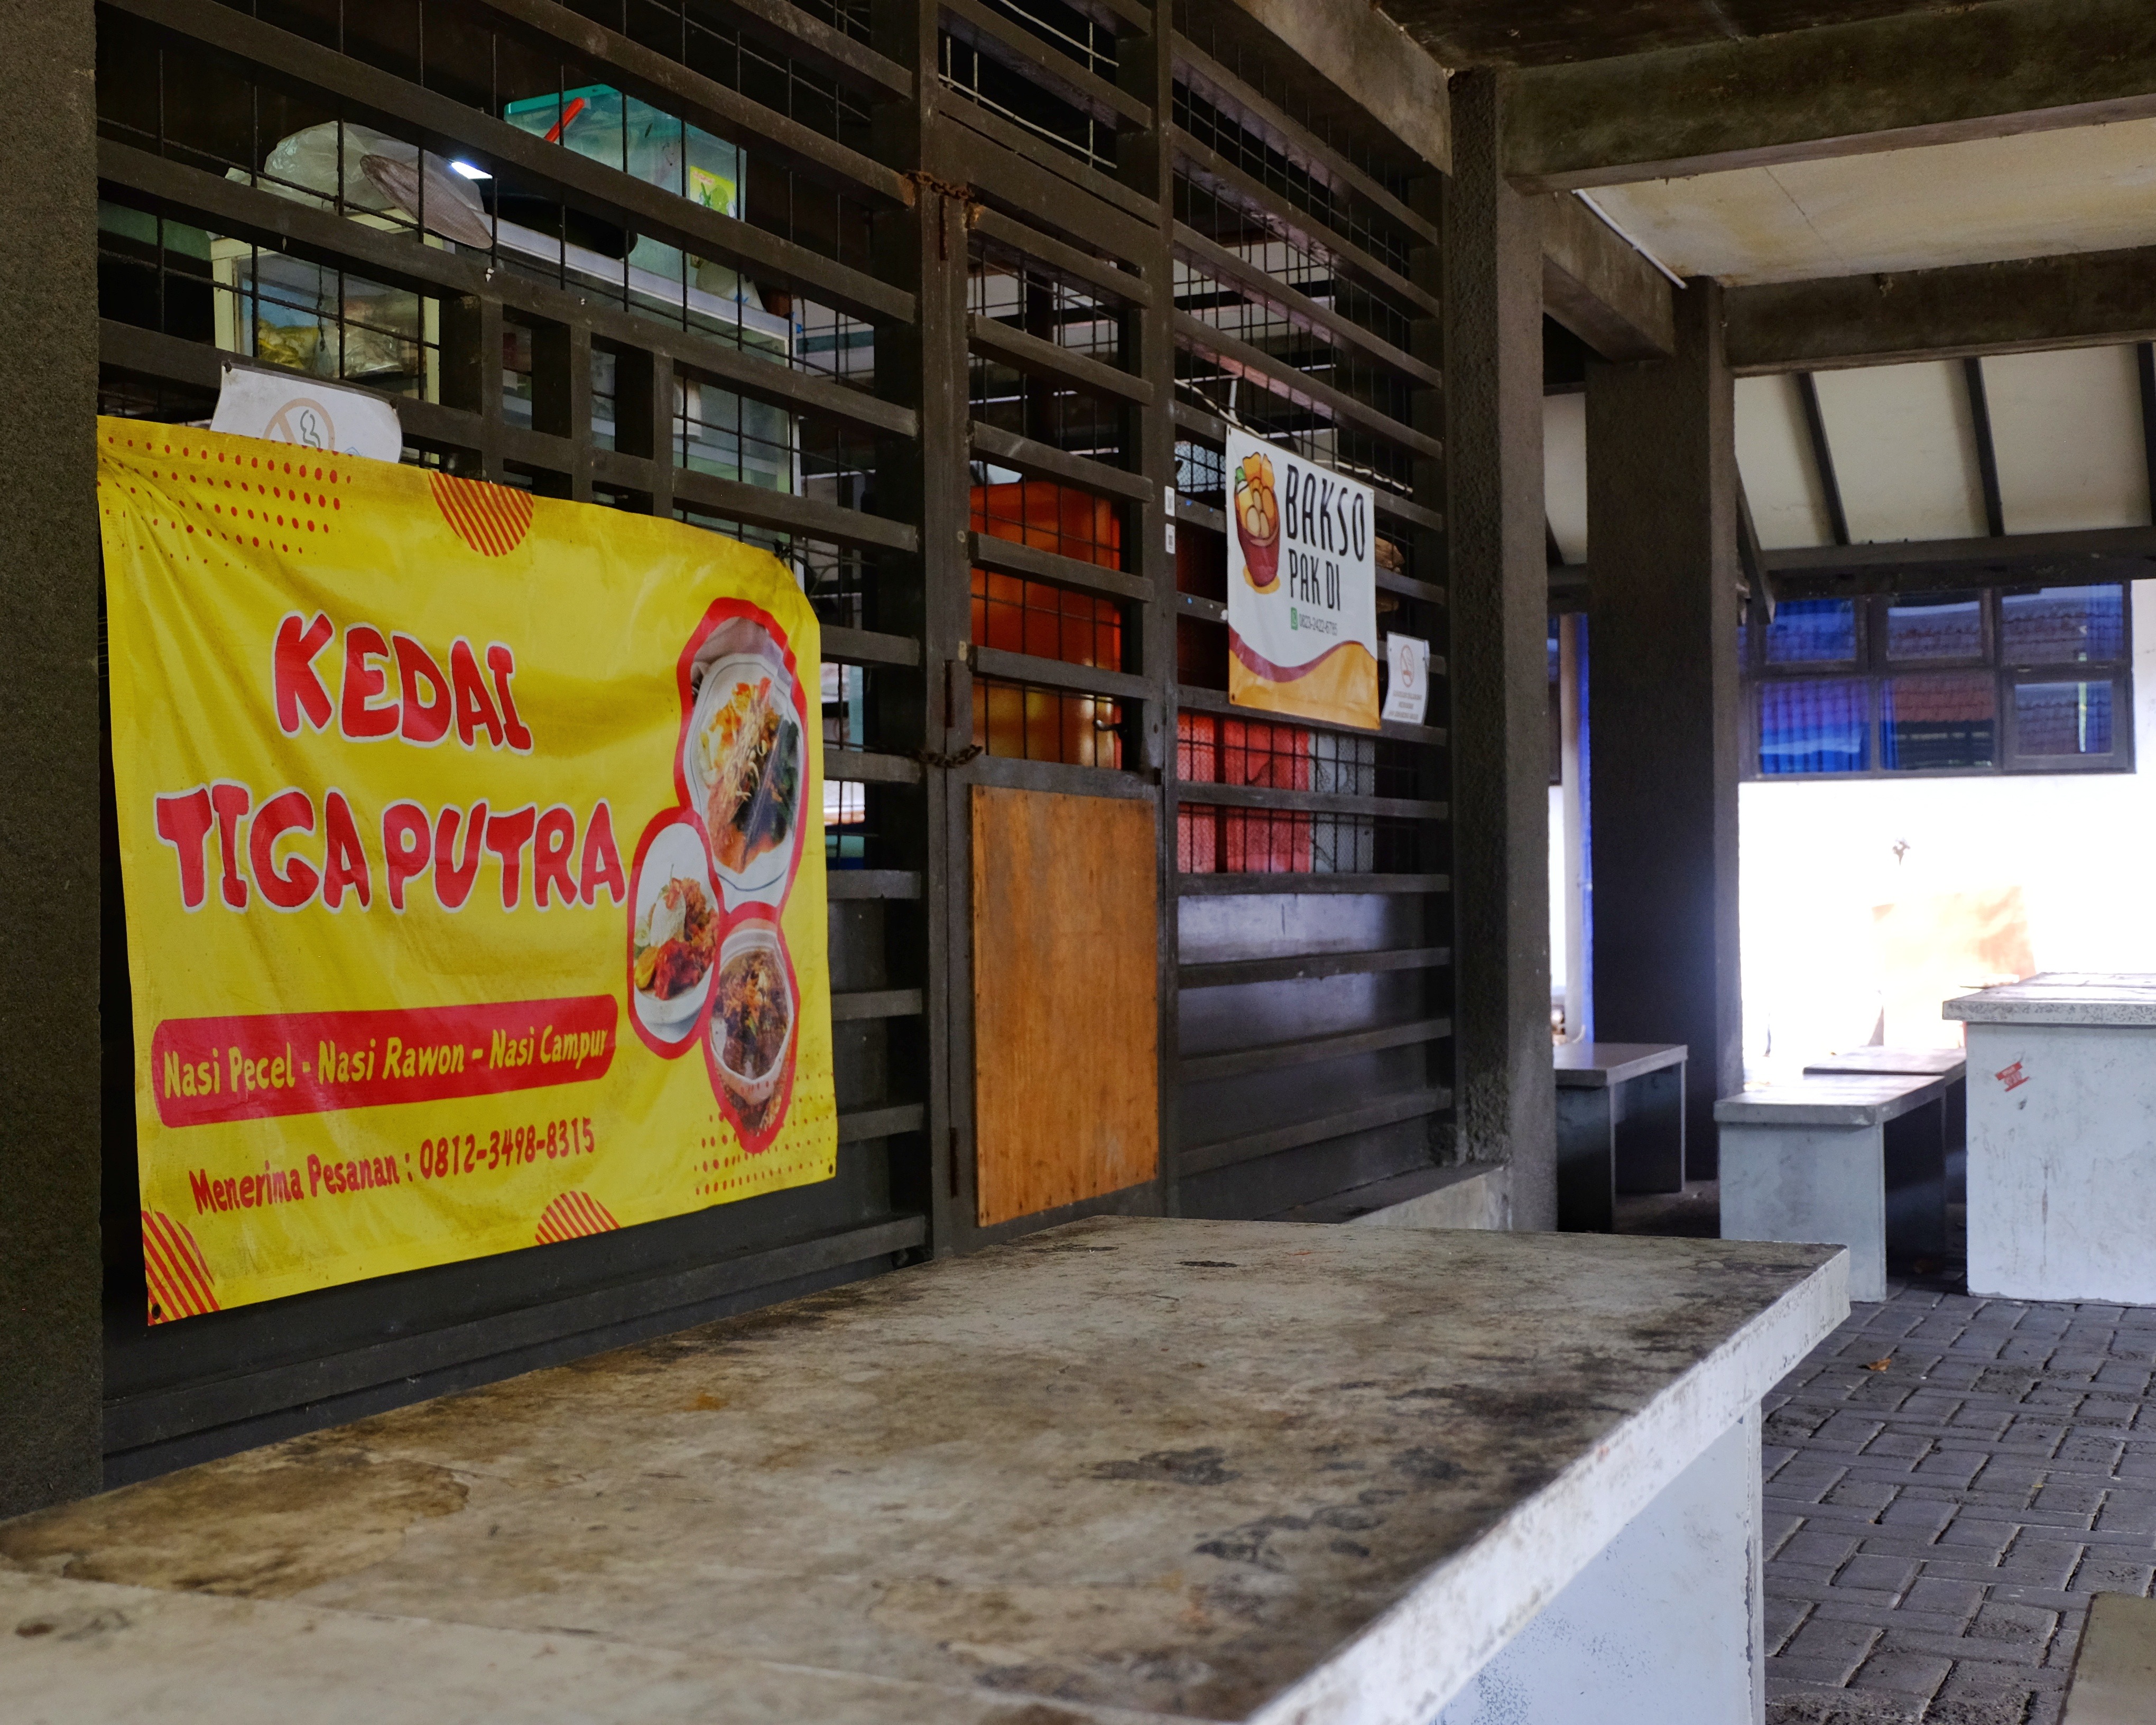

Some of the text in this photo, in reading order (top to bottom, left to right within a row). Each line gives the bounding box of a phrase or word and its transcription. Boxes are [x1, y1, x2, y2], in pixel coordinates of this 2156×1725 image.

[1286, 463, 1365, 562] BAKSO
[1288, 548, 1340, 611] PAK DI
[272, 610, 534, 753] KEDAI
[154, 779, 627, 913] TIGA PUTRA
[164, 1047, 220, 1099] Nasi
[228, 1042, 295, 1092] Pecel
[319, 1038, 376, 1084] Nasi
[382, 1036, 464, 1079] Rawon
[489, 1026, 534, 1069] Nasi
[540, 1025, 608, 1070] Campur
[189, 1160, 304, 1215] Menerima
[307, 1154, 400, 1197] Pesanan
[420, 1117, 595, 1179] 0812-3498-8315
